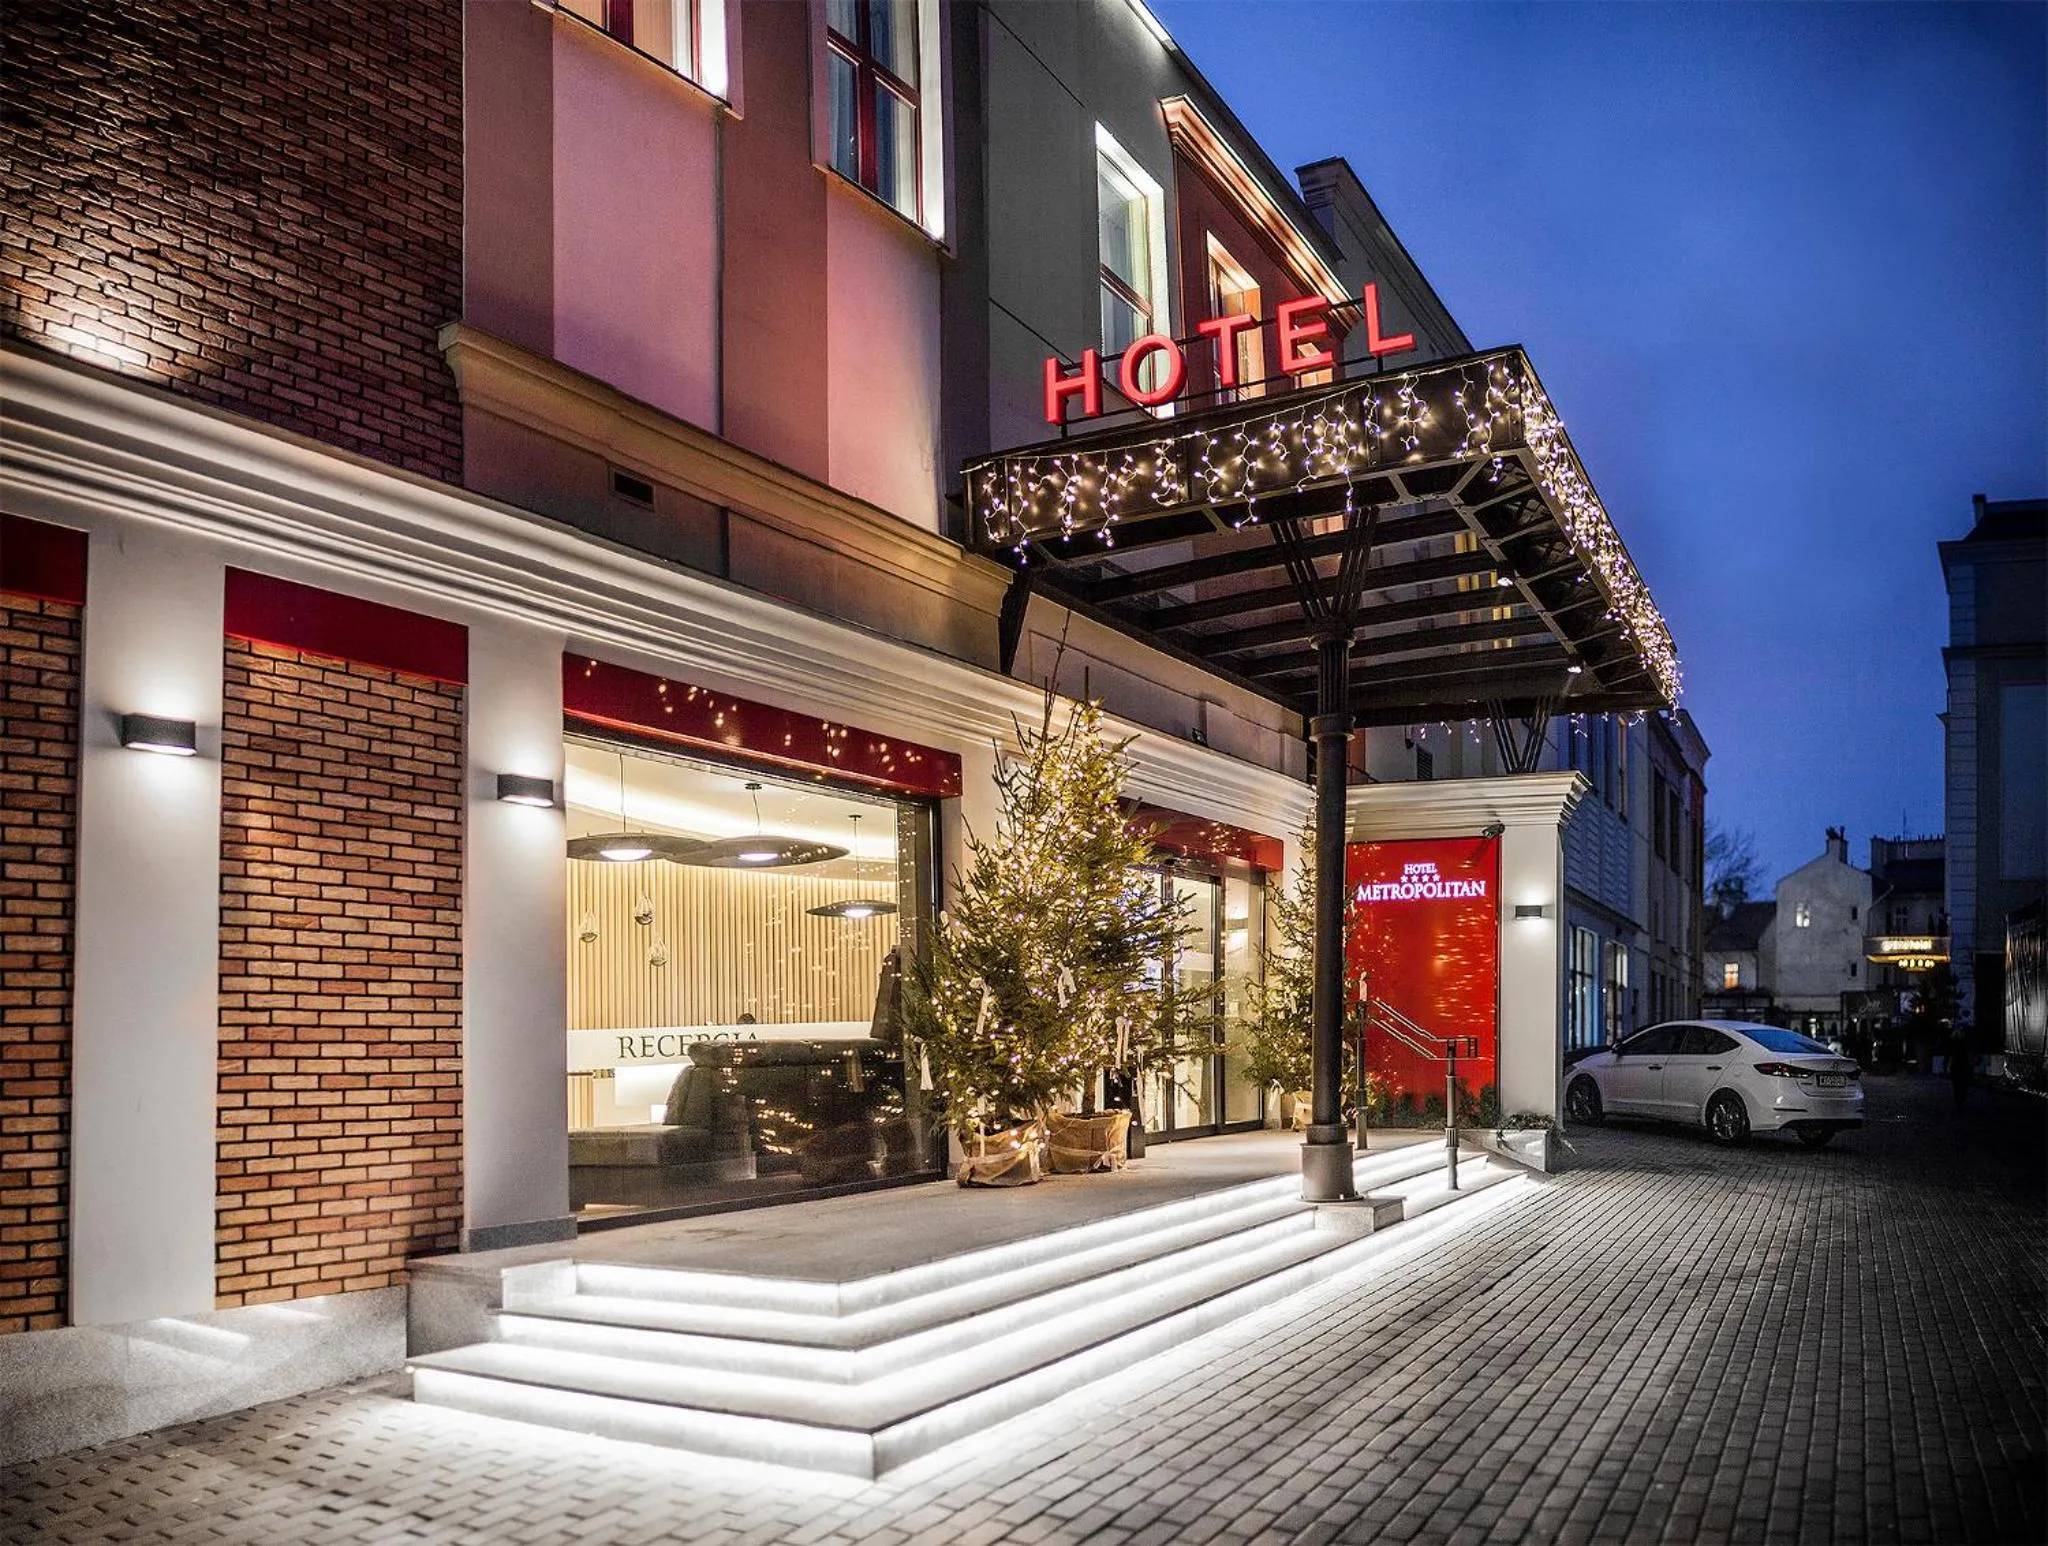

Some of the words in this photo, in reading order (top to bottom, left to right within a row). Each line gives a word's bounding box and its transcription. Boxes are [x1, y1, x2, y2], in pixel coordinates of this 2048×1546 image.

[1045, 283, 1414, 425] HOTEL
[1404, 863, 1437, 875] HOTEL
[1357, 881, 1486, 901] METROPOLITAN
